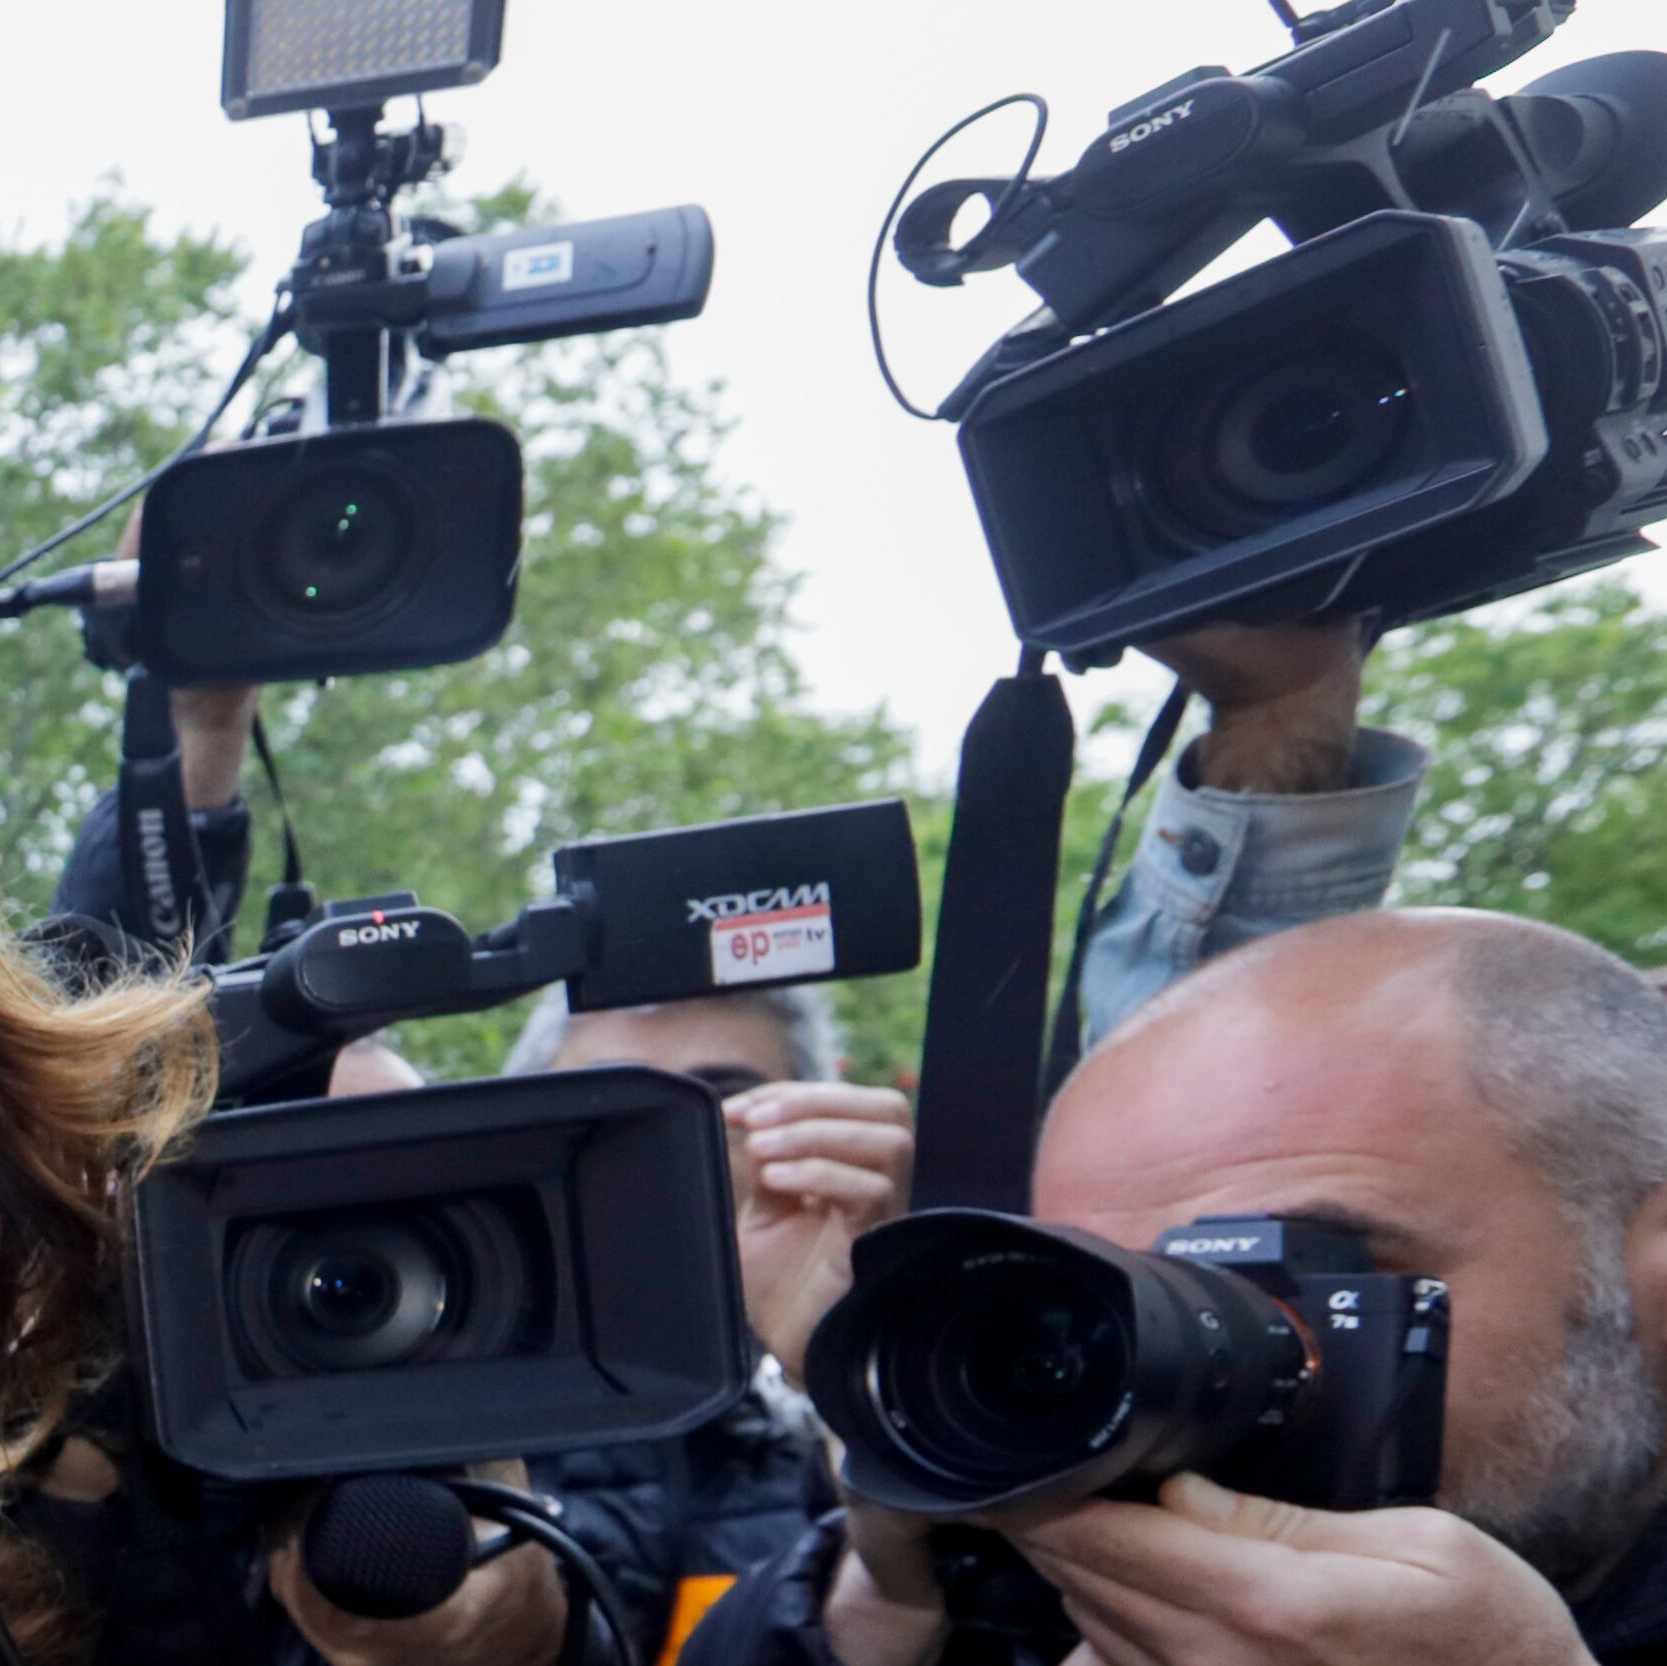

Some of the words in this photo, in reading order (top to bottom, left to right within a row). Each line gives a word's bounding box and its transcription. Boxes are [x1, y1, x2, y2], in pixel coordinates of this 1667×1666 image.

[1109, 99, 1197, 154] SONY
[138, 808, 182, 937] Canon
[687, 881, 831, 924] XDCAM
[338, 919, 421, 948] SONY
[731, 929, 771, 966] ep
[1165, 1236, 1261, 1255] SONY
